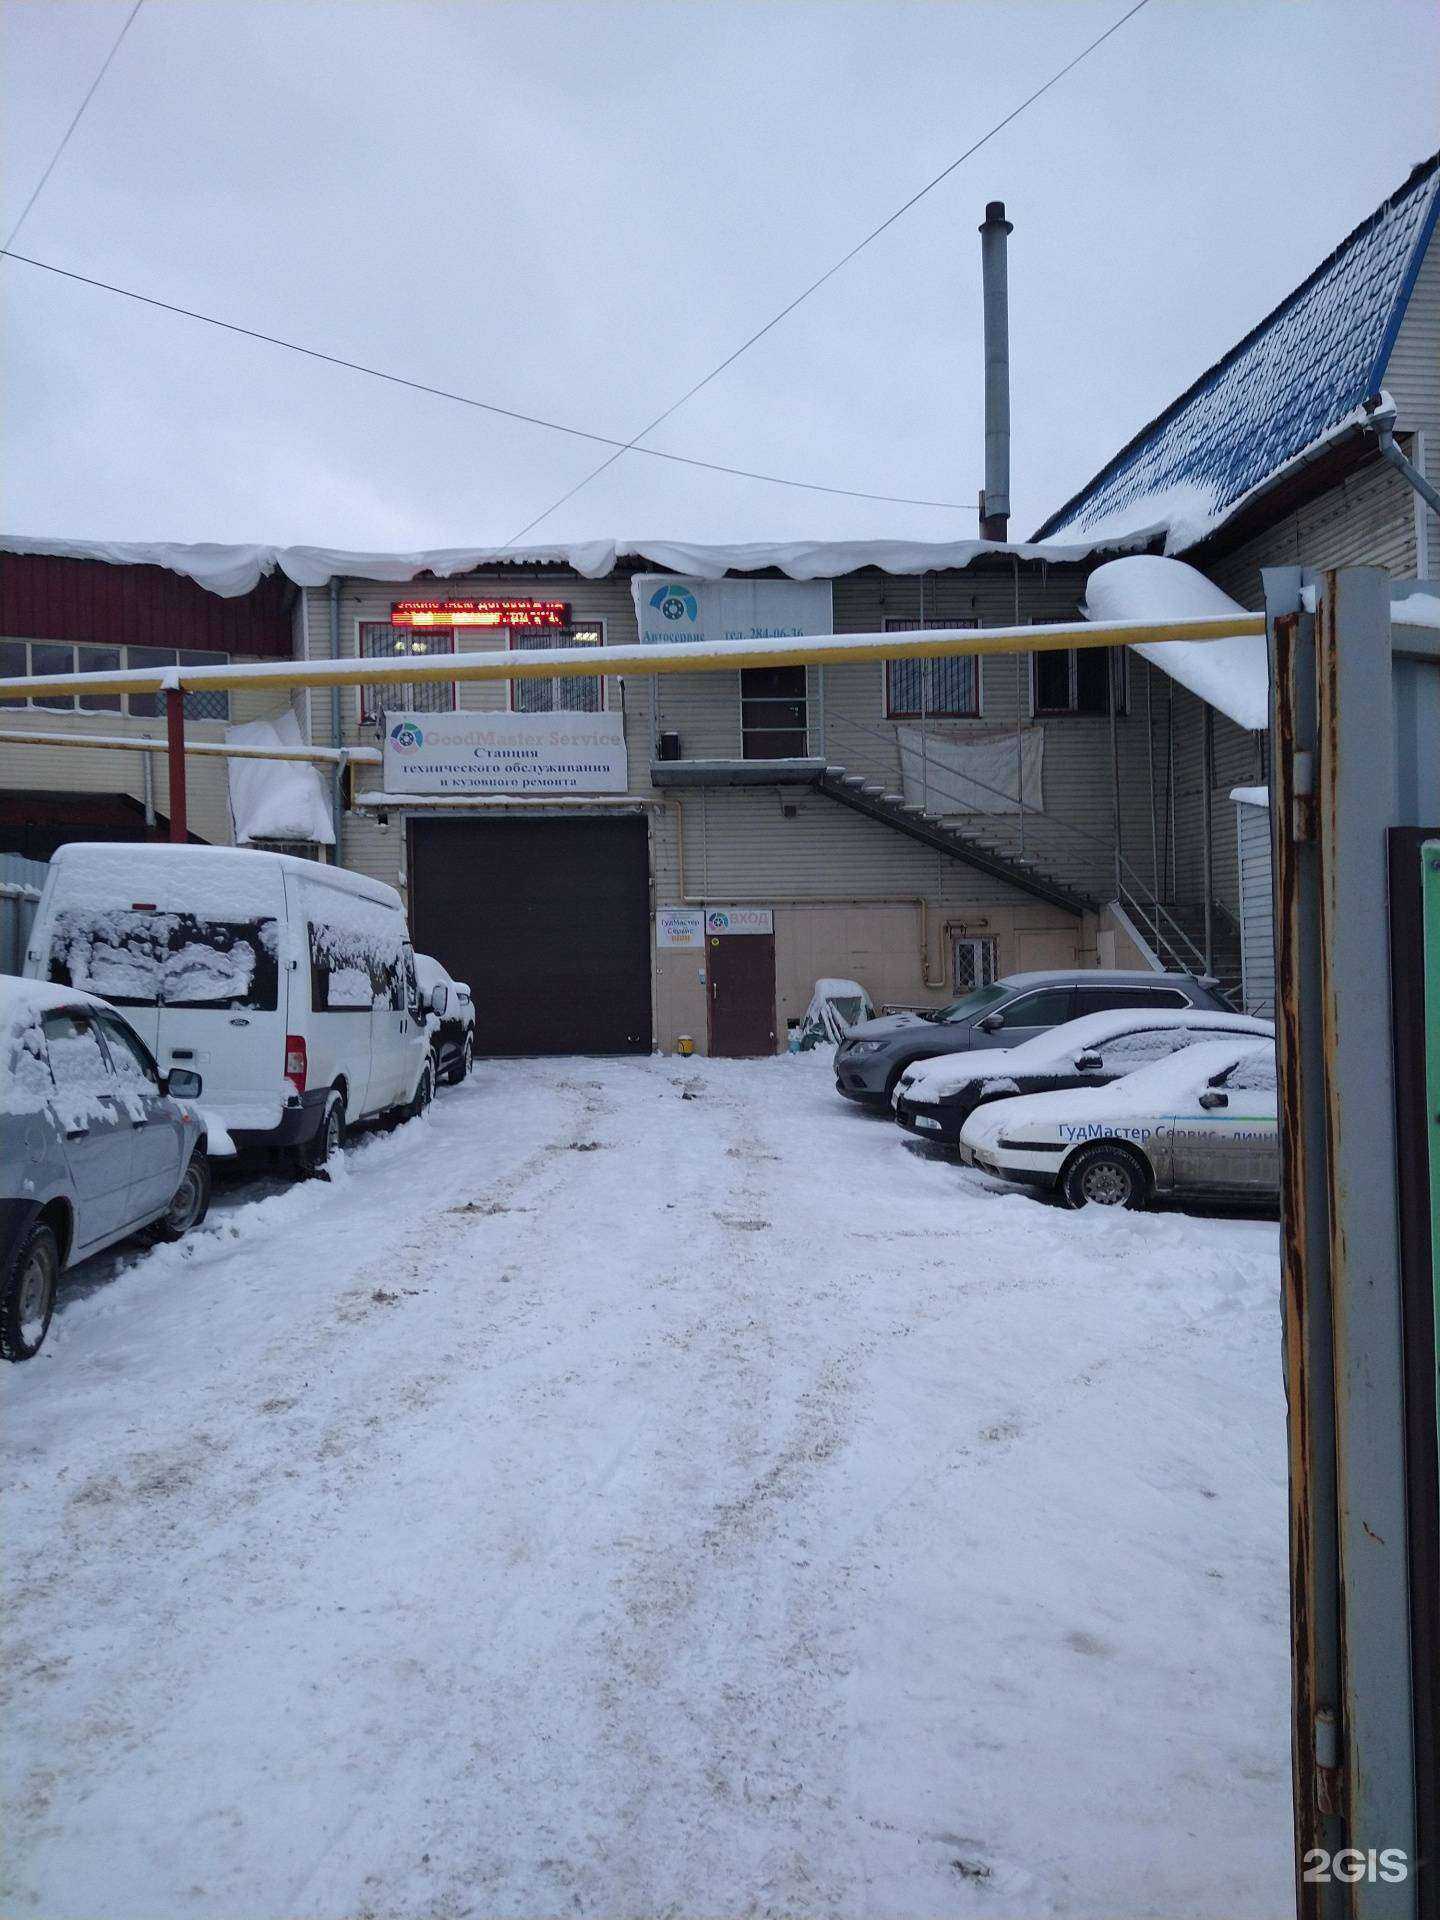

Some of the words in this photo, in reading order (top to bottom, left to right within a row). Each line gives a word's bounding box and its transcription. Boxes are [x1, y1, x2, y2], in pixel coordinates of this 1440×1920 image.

[550, 732, 621, 746] Service
[474, 747, 538, 758] Станция
[402, 764, 500, 773] технического
[505, 762, 610, 775] обслуживания
[452, 779, 519, 788] кузовного
[522, 779, 577, 788] ремонта
[730, 912, 769, 925] ВХОД
[1058, 1124, 1150, 1141] ГудМастер
